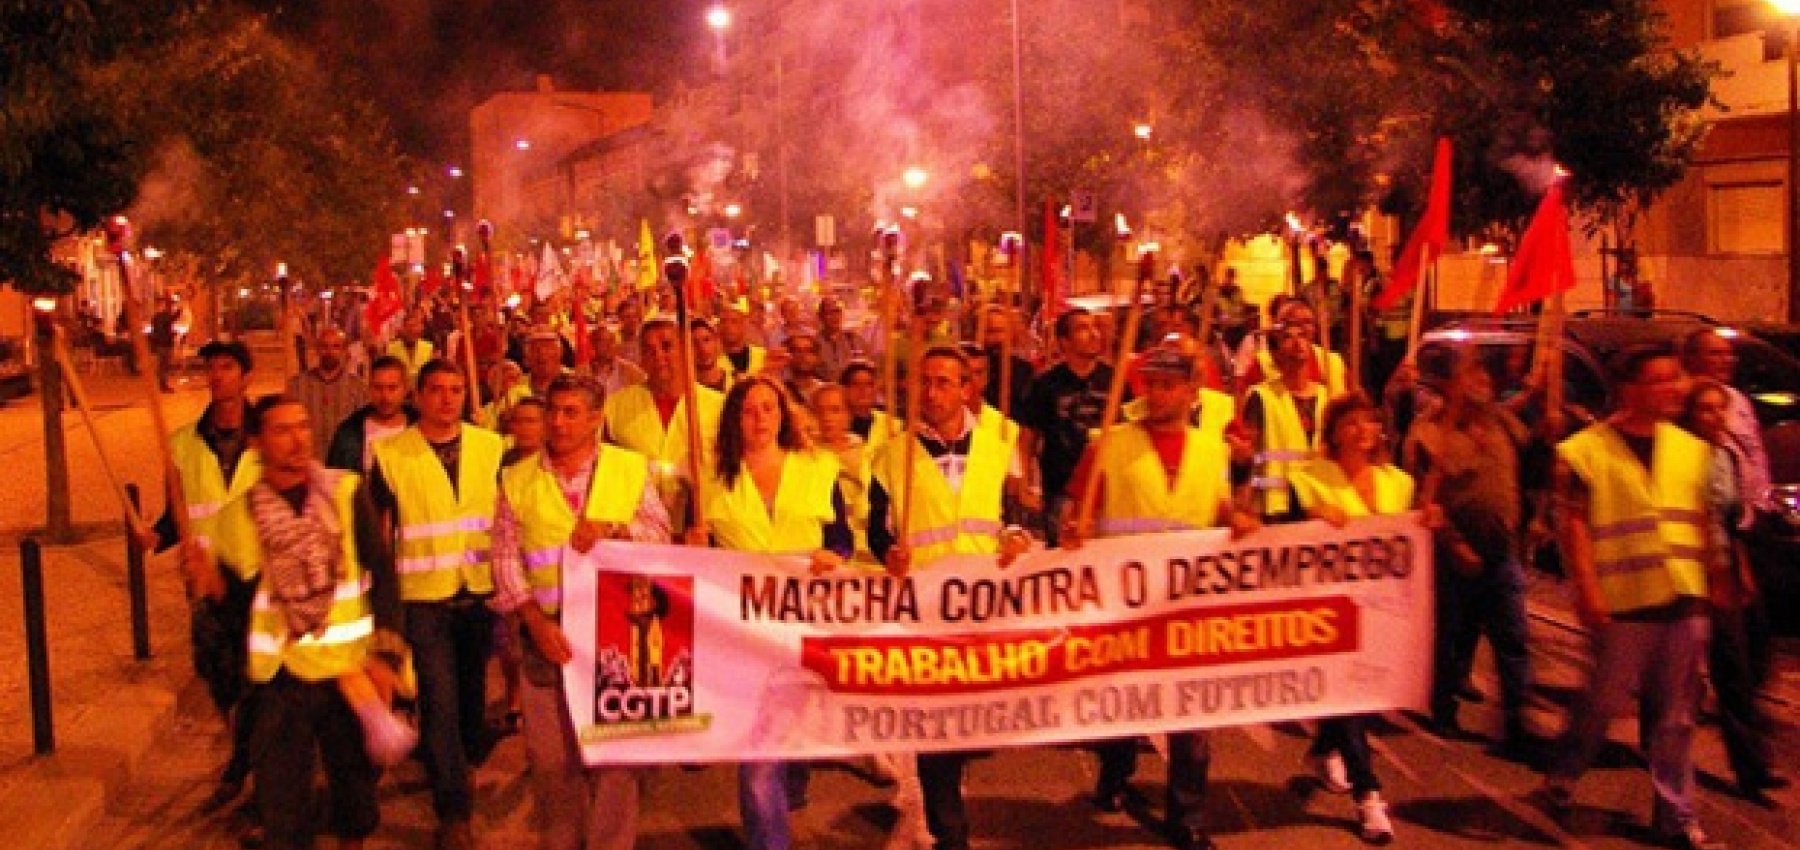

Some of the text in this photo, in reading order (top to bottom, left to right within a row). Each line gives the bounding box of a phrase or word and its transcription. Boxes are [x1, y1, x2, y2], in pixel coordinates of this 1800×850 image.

[739, 534, 1412, 624] MARCHA CONTRA O DESEMPREGO
[831, 608, 1339, 686] TRABALHO COM DIREITOS
[598, 686, 690, 721] CGTP
[843, 666, 1326, 743] PORTUGAL COM FUTURO
